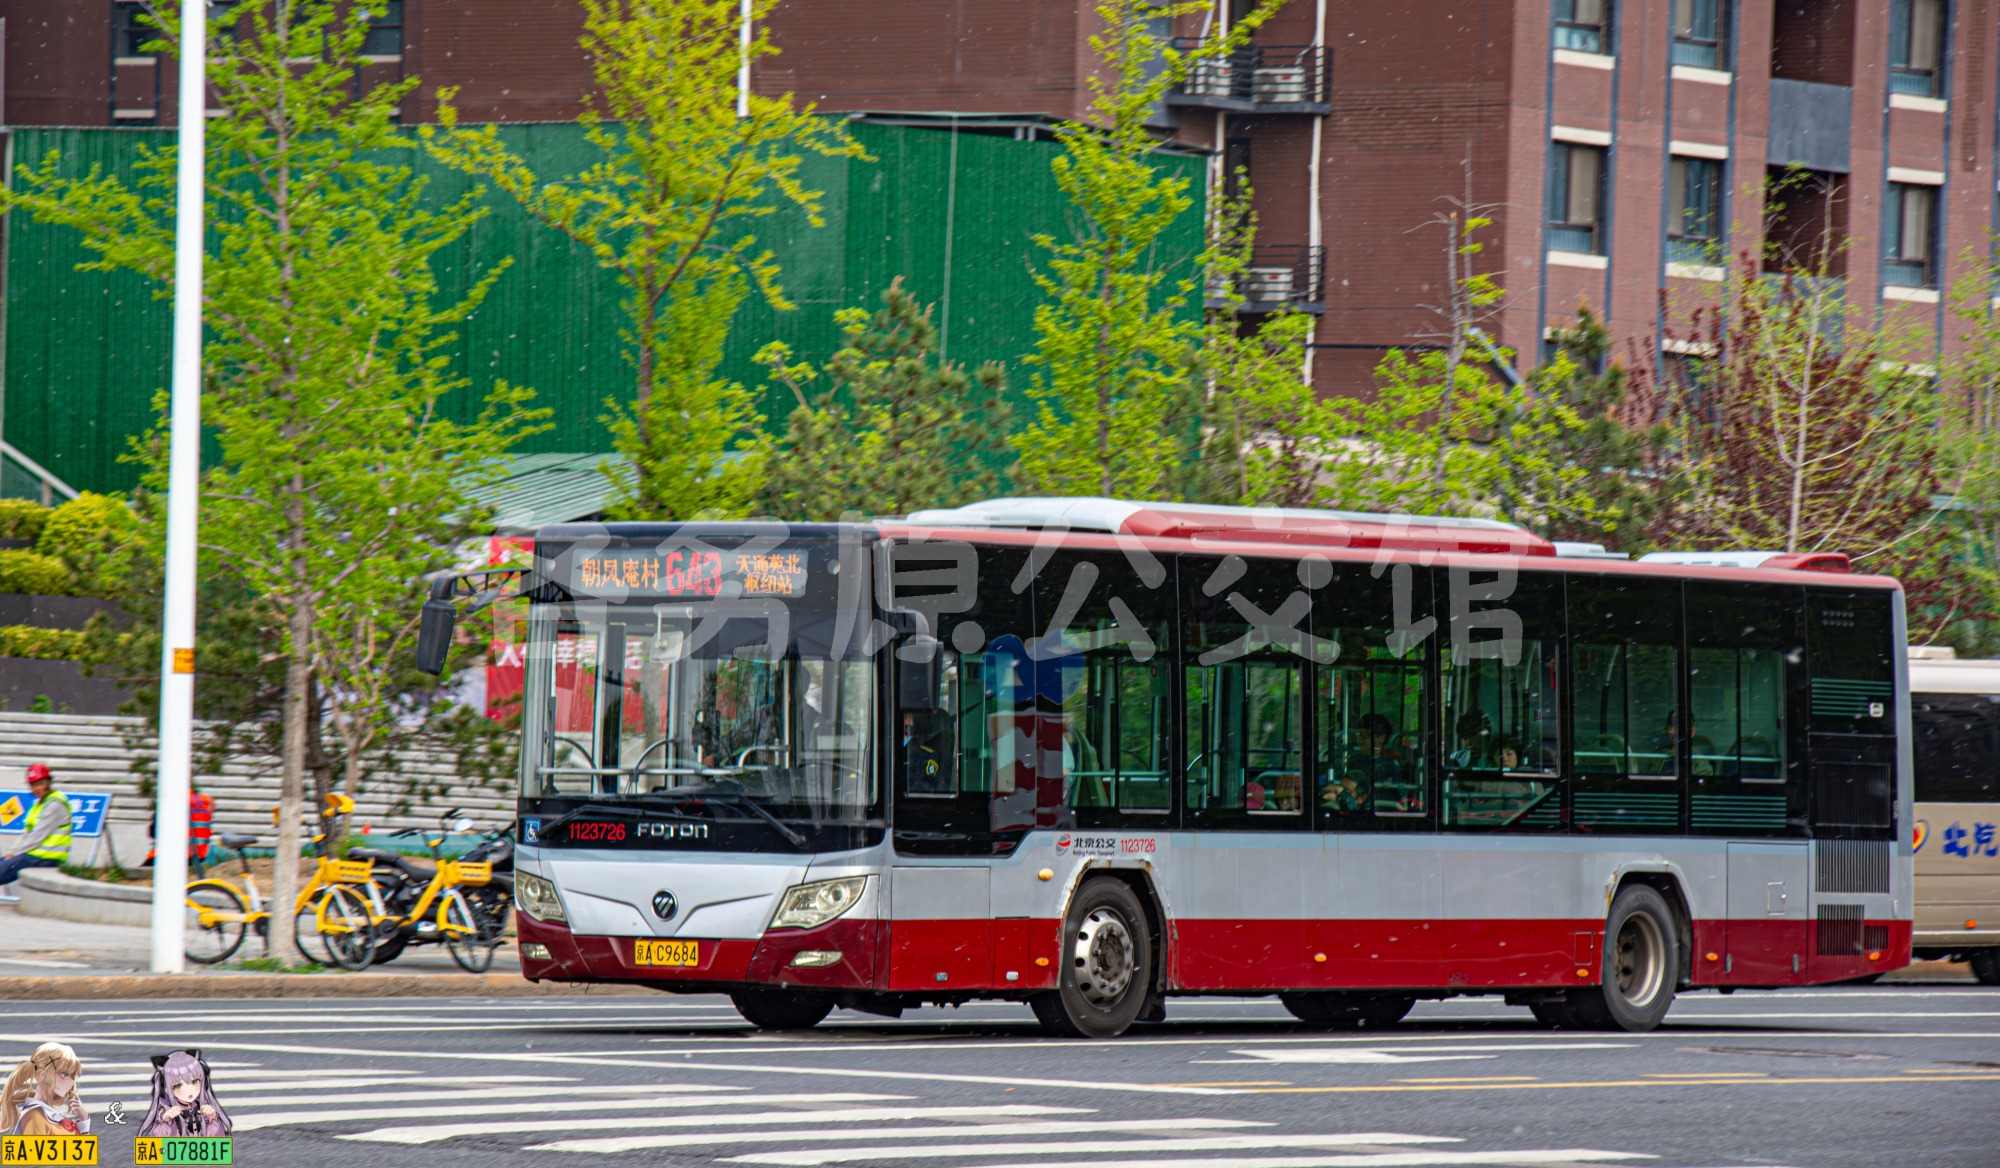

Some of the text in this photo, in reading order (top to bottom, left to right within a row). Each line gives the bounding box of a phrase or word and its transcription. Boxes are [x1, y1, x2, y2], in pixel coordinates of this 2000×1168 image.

[666, 551, 723, 596] 643
[735, 553, 801, 575] 天通苑北
[743, 573, 793, 595] 枢纽站
[568, 822, 708, 841] 1123726 FOTON
[1073, 837, 1156, 853] 北京公交 1123726
